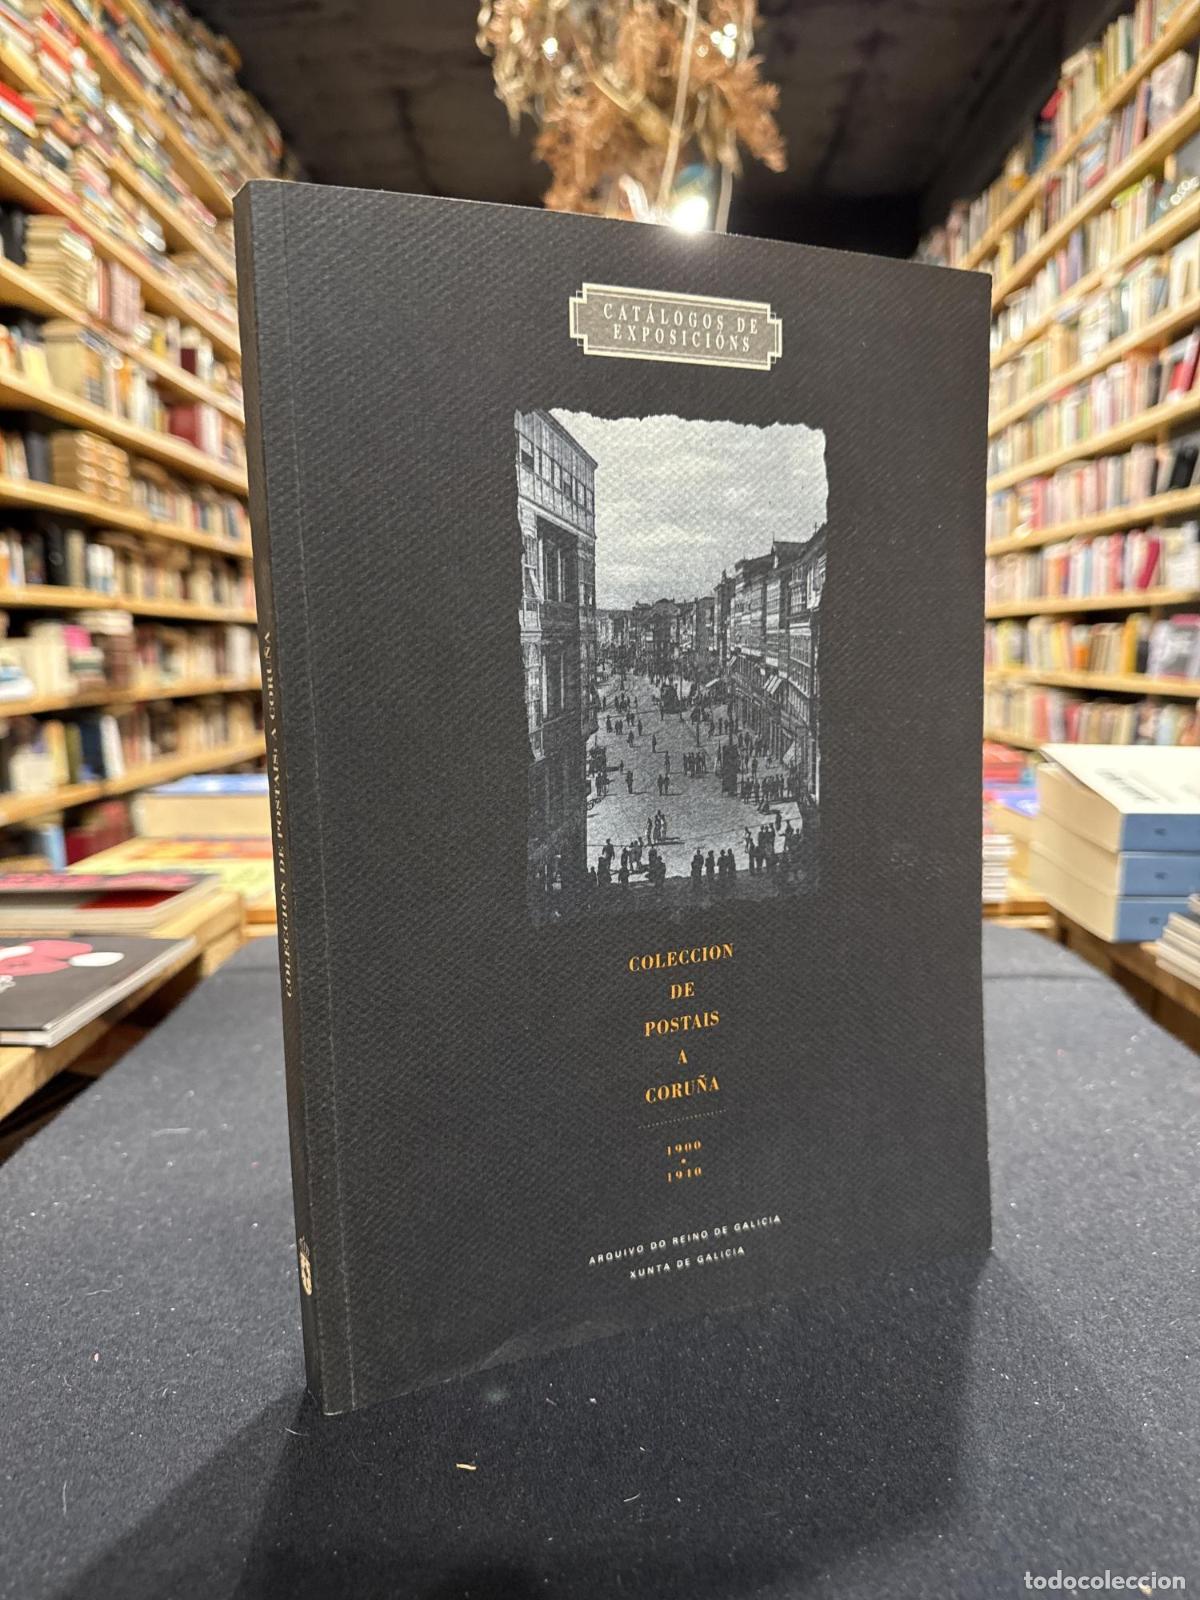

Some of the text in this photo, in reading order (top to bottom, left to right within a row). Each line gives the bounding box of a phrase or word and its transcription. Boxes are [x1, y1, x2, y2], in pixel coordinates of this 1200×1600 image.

[603, 303, 758, 334] CATÁLOGOS DE
[613, 323, 750, 353] EXPOSICIÓNS
[277, 845, 287, 874] DE
[278, 882, 293, 998] COLECCION
[628, 942, 734, 972] COLECCION
[670, 981, 695, 1000] DE
[643, 1010, 720, 1037] POSTAIS
[677, 1049, 688, 1065] A
[644, 1073, 720, 1104] CORUÑA
[666, 1140, 702, 1157] 1900
[666, 1167, 702, 1183] 1910
[588, 1214, 781, 1266] ARQUIVO DO REINO DE GALICIA
[629, 1245, 745, 1280] XUNTA DE GALICIA
